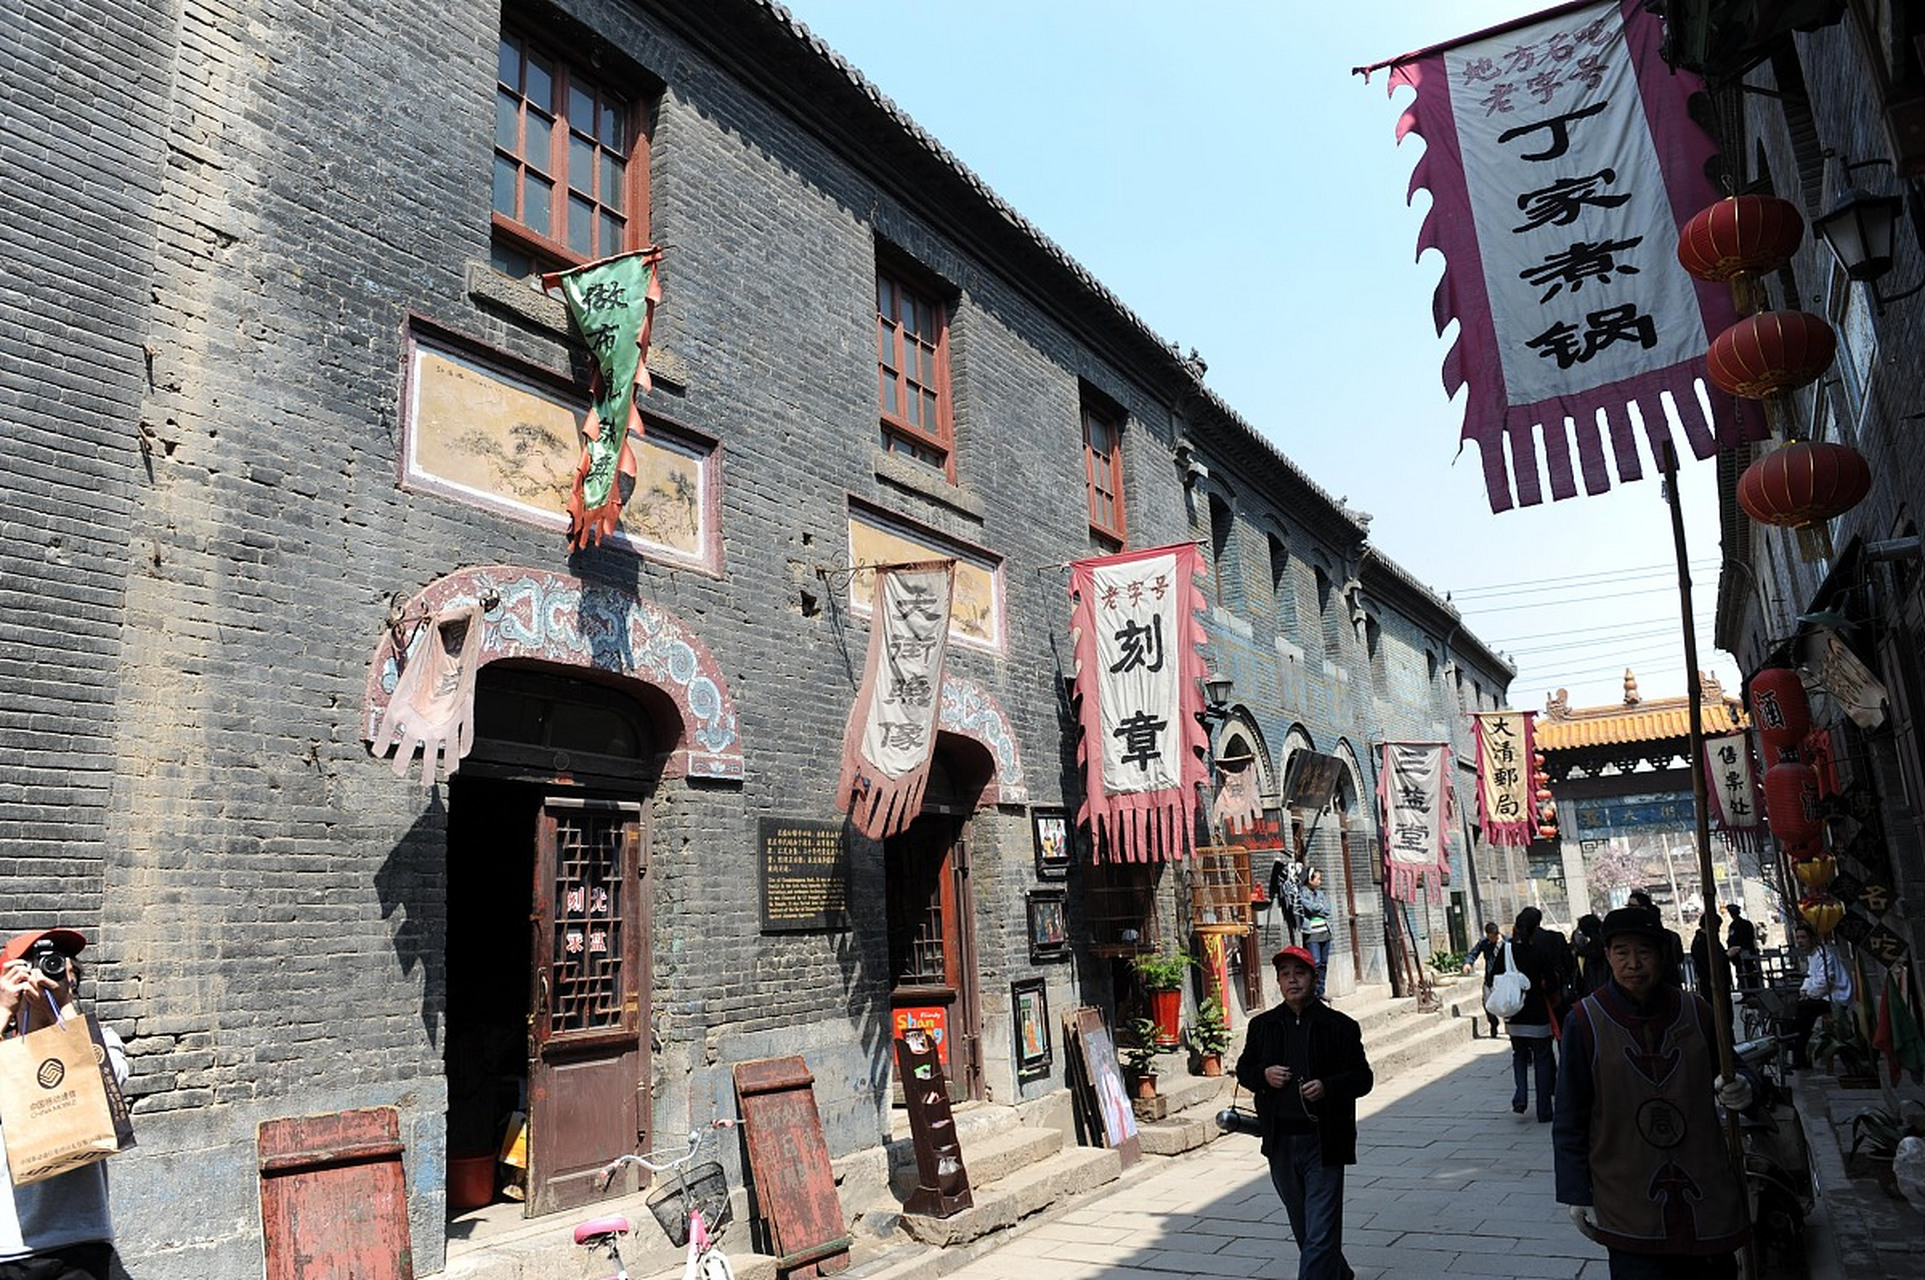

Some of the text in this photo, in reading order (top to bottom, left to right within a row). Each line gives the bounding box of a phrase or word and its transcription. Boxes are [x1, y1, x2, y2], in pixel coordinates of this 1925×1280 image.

[1463, 18, 1614, 86] 地方名吃
[1480, 54, 1609, 117] 老字号
[1498, 101, 1658, 370] 丁家煮锅
[1101, 574, 1169, 611] 老字号
[1109, 612, 1168, 772] 刻章
[1393, 751, 1432, 854] 三益堂
[1489, 717, 1519, 817] 大清郵局
[1717, 745, 1751, 816] 售票处
